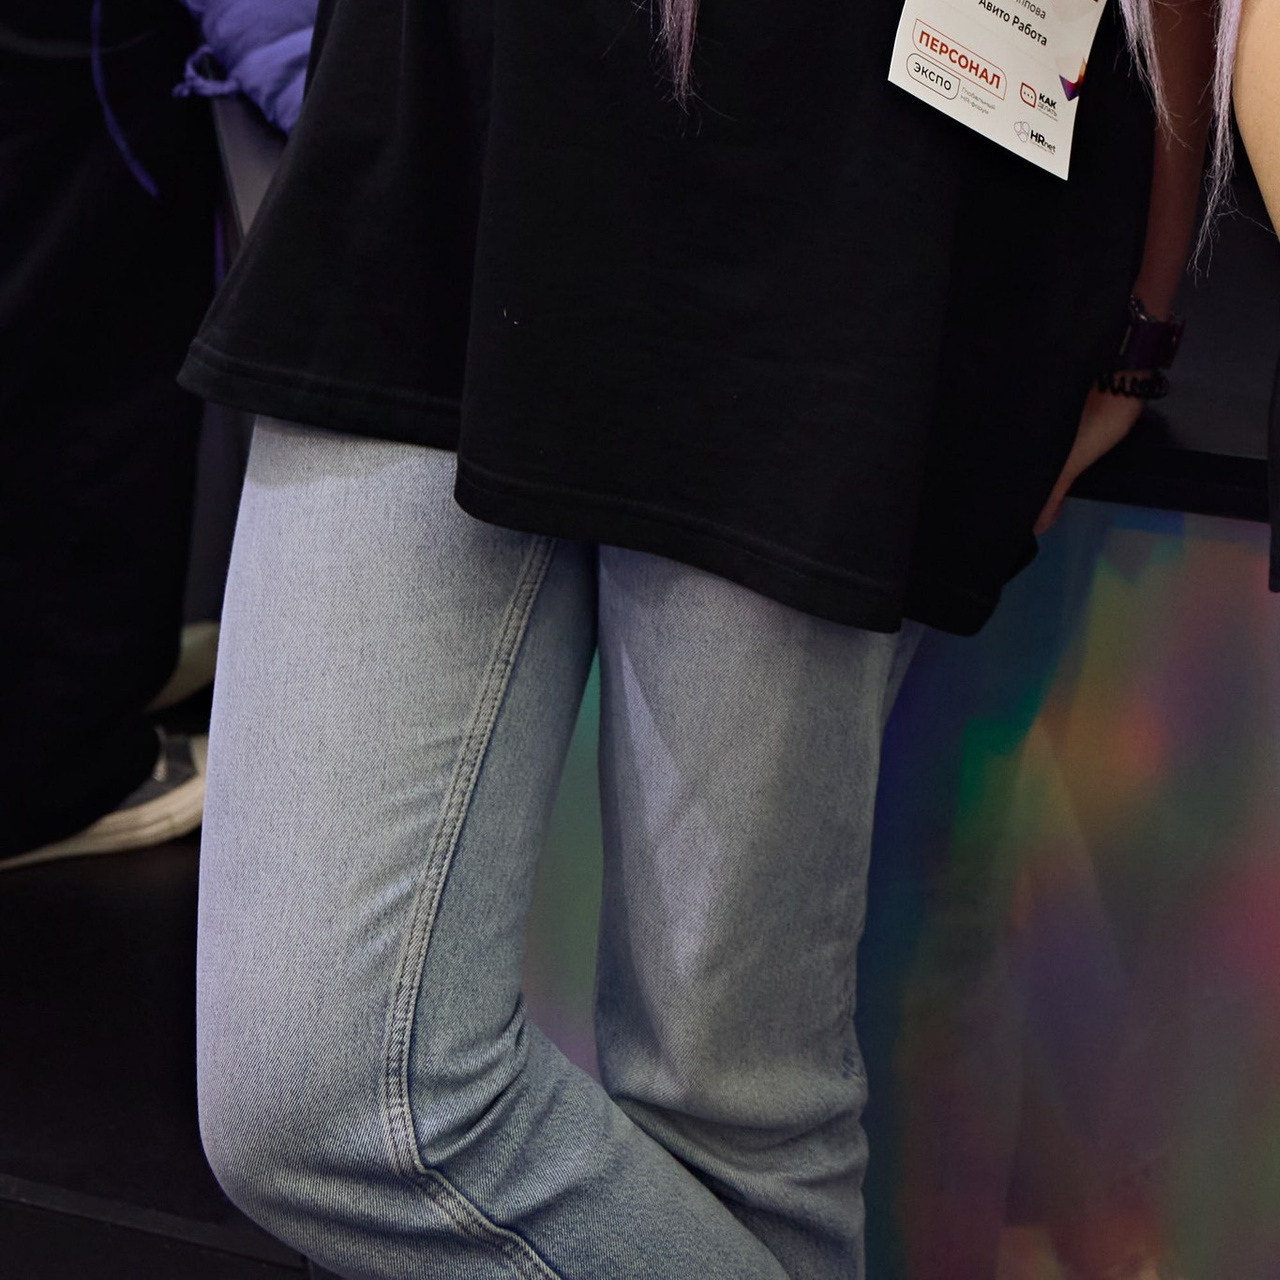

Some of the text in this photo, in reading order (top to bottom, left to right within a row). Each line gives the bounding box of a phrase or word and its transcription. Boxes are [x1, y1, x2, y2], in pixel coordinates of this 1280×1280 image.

[1012, 12, 1048, 46] Работа
[918, 30, 1001, 89] ПЕРСОНАЛ
[913, 62, 952, 91] ЭКСПО
[1038, 91, 1057, 109] КАК
[1029, 128, 1056, 154] HRnet
